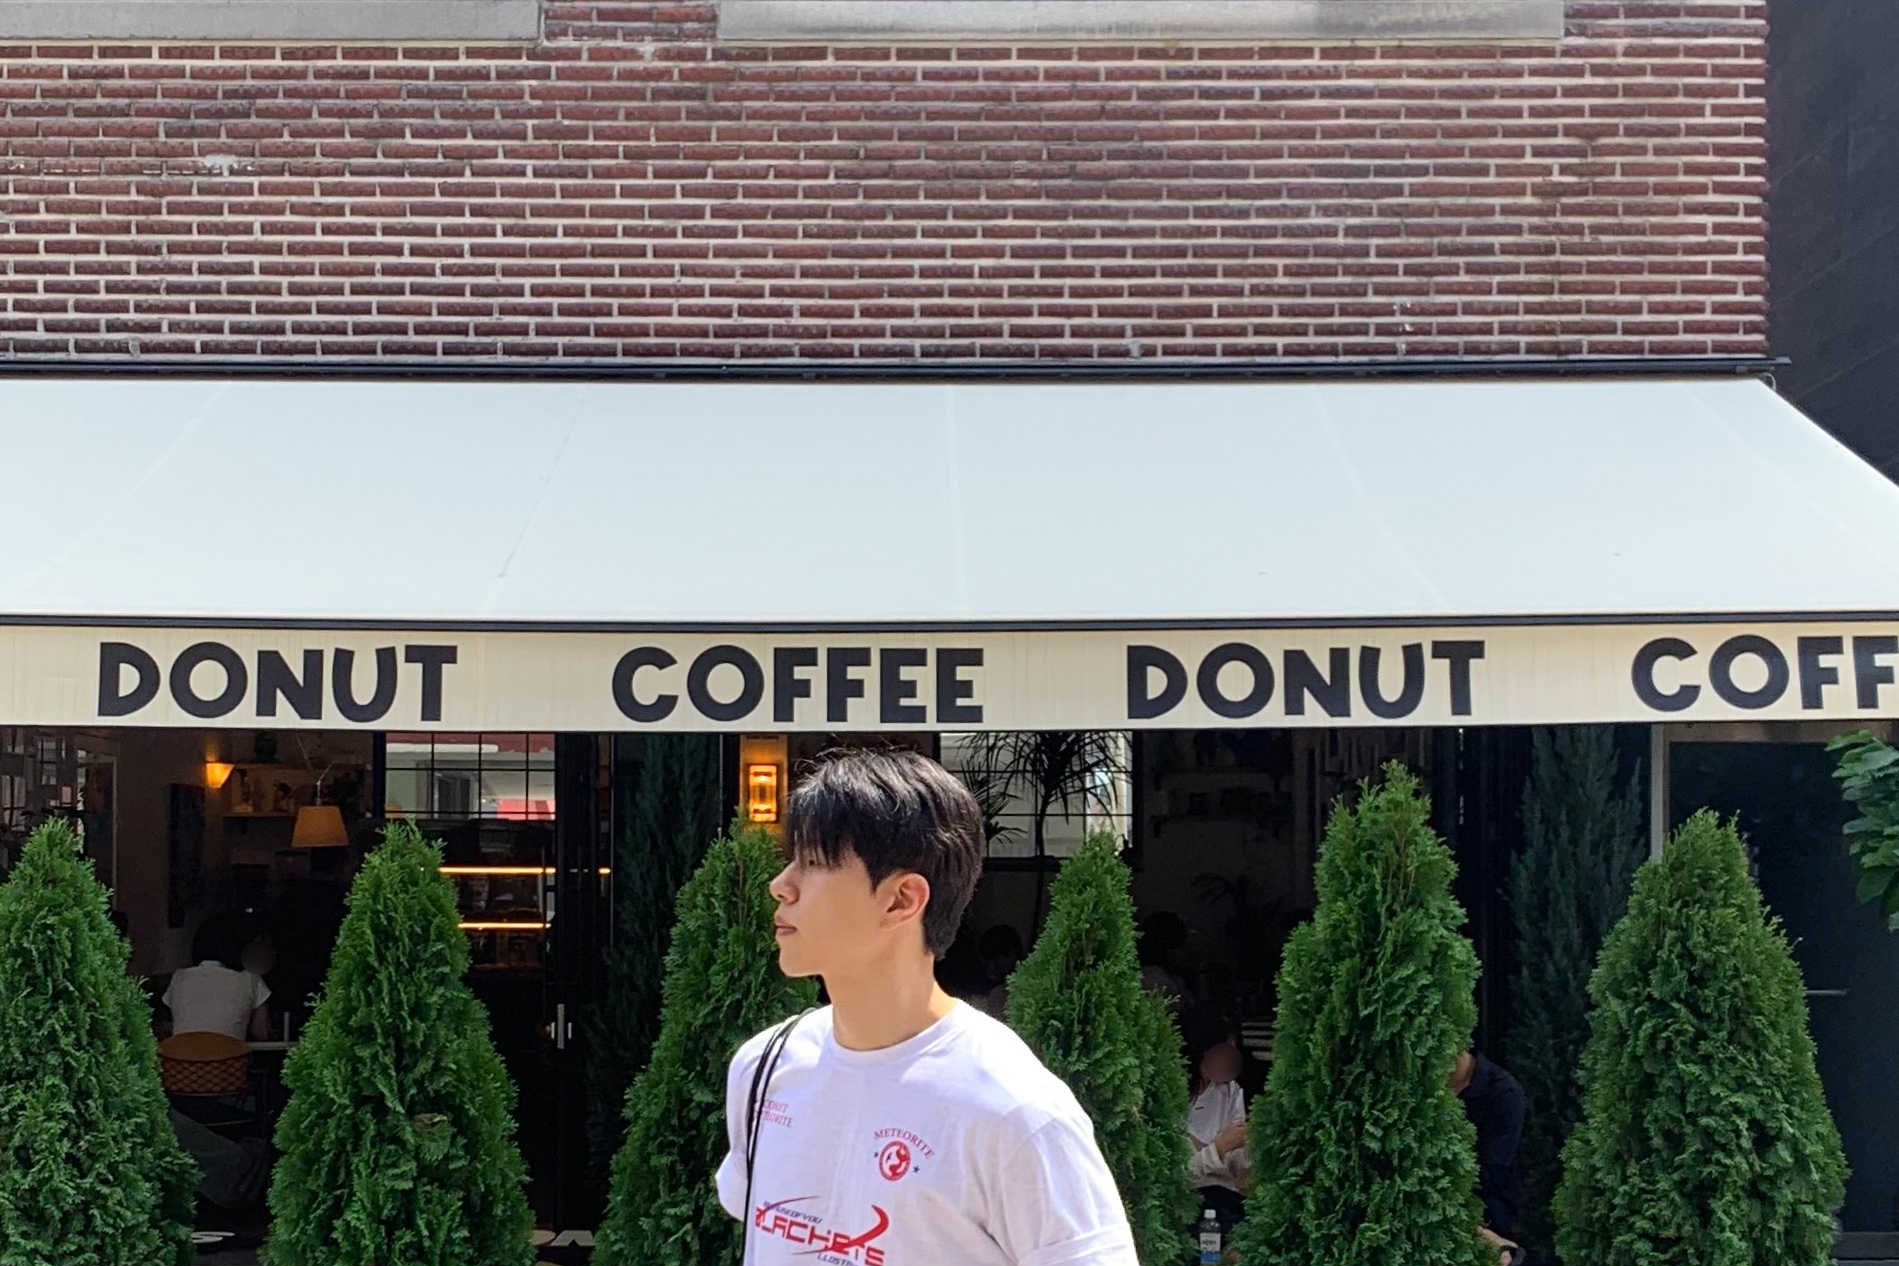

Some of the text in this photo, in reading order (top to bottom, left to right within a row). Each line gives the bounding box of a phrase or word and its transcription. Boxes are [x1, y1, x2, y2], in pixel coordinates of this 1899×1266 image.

[97, 634, 1899, 724] DONUT COFFEE DONUT COFF
[874, 1128, 934, 1159] METEORITE
